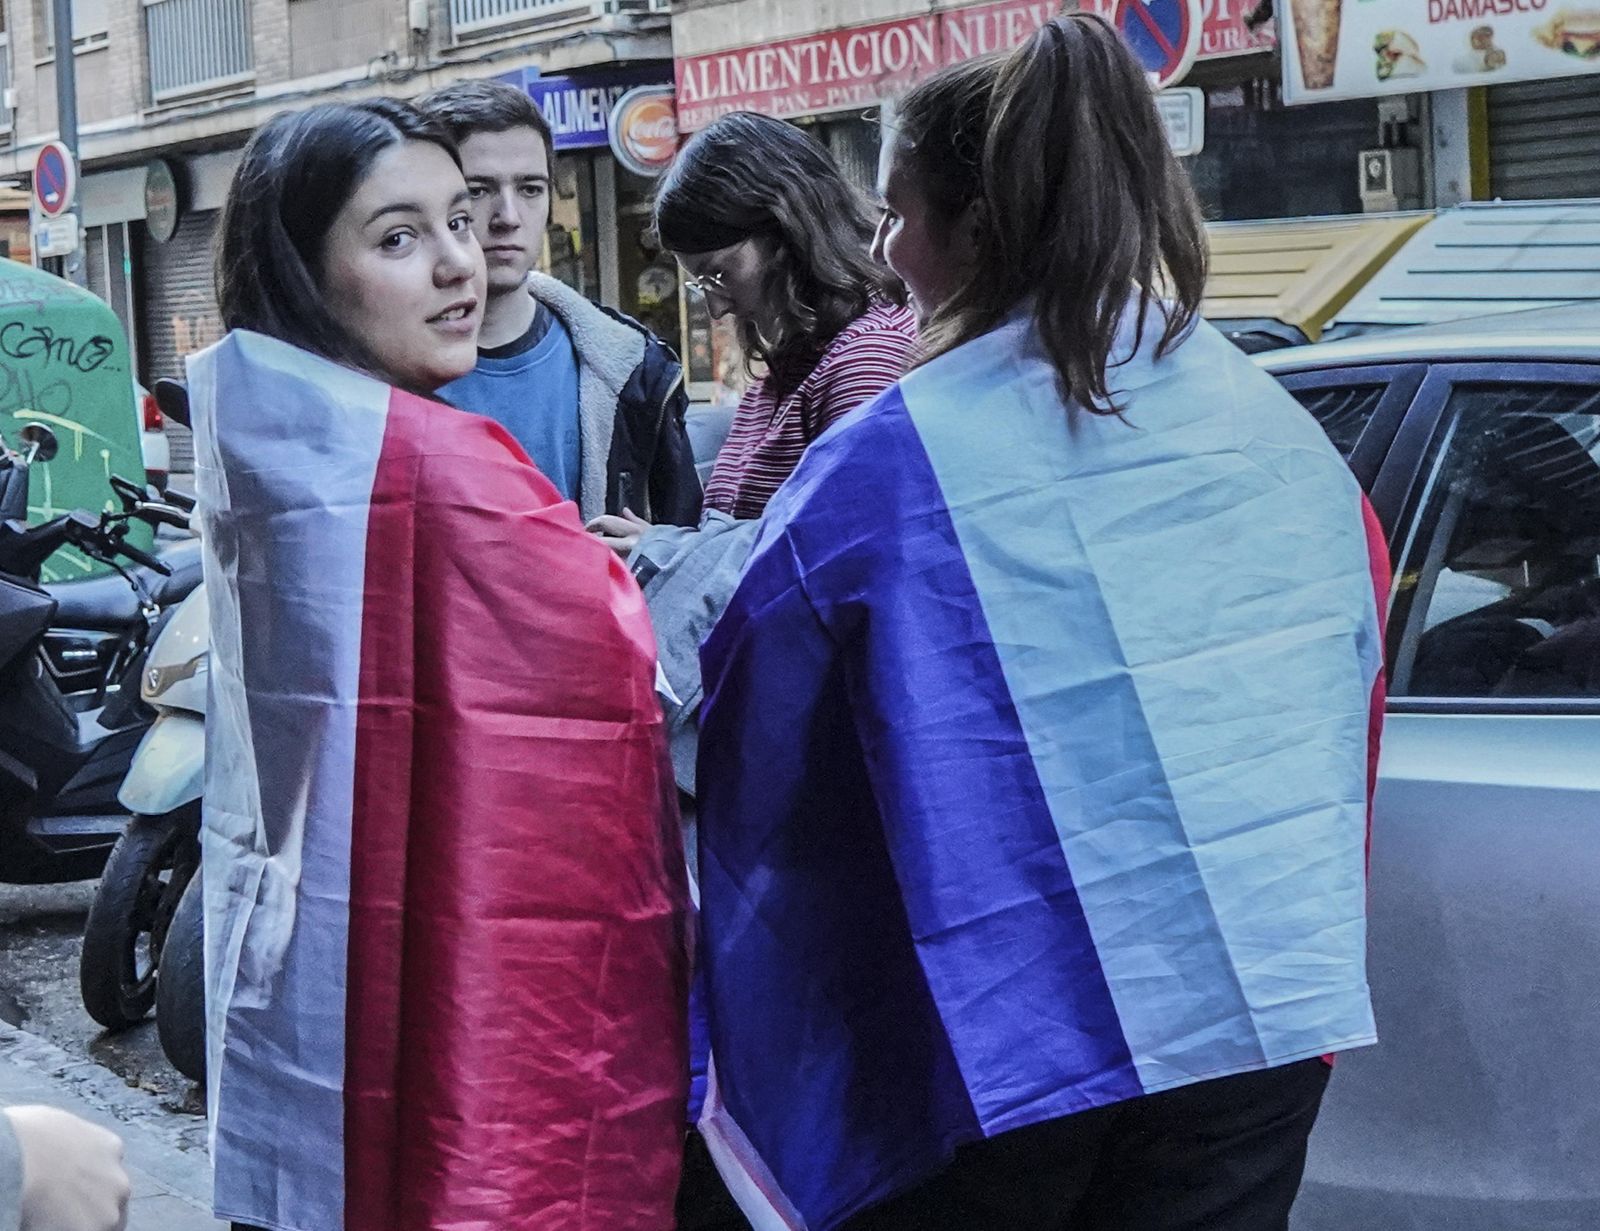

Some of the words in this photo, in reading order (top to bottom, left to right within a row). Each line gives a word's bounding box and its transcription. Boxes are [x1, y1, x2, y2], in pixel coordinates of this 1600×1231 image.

[679, 19, 935, 104] ALIMENTACION
[946, 3, 1057, 66] NUEV
[772, 91, 810, 115] PAN
